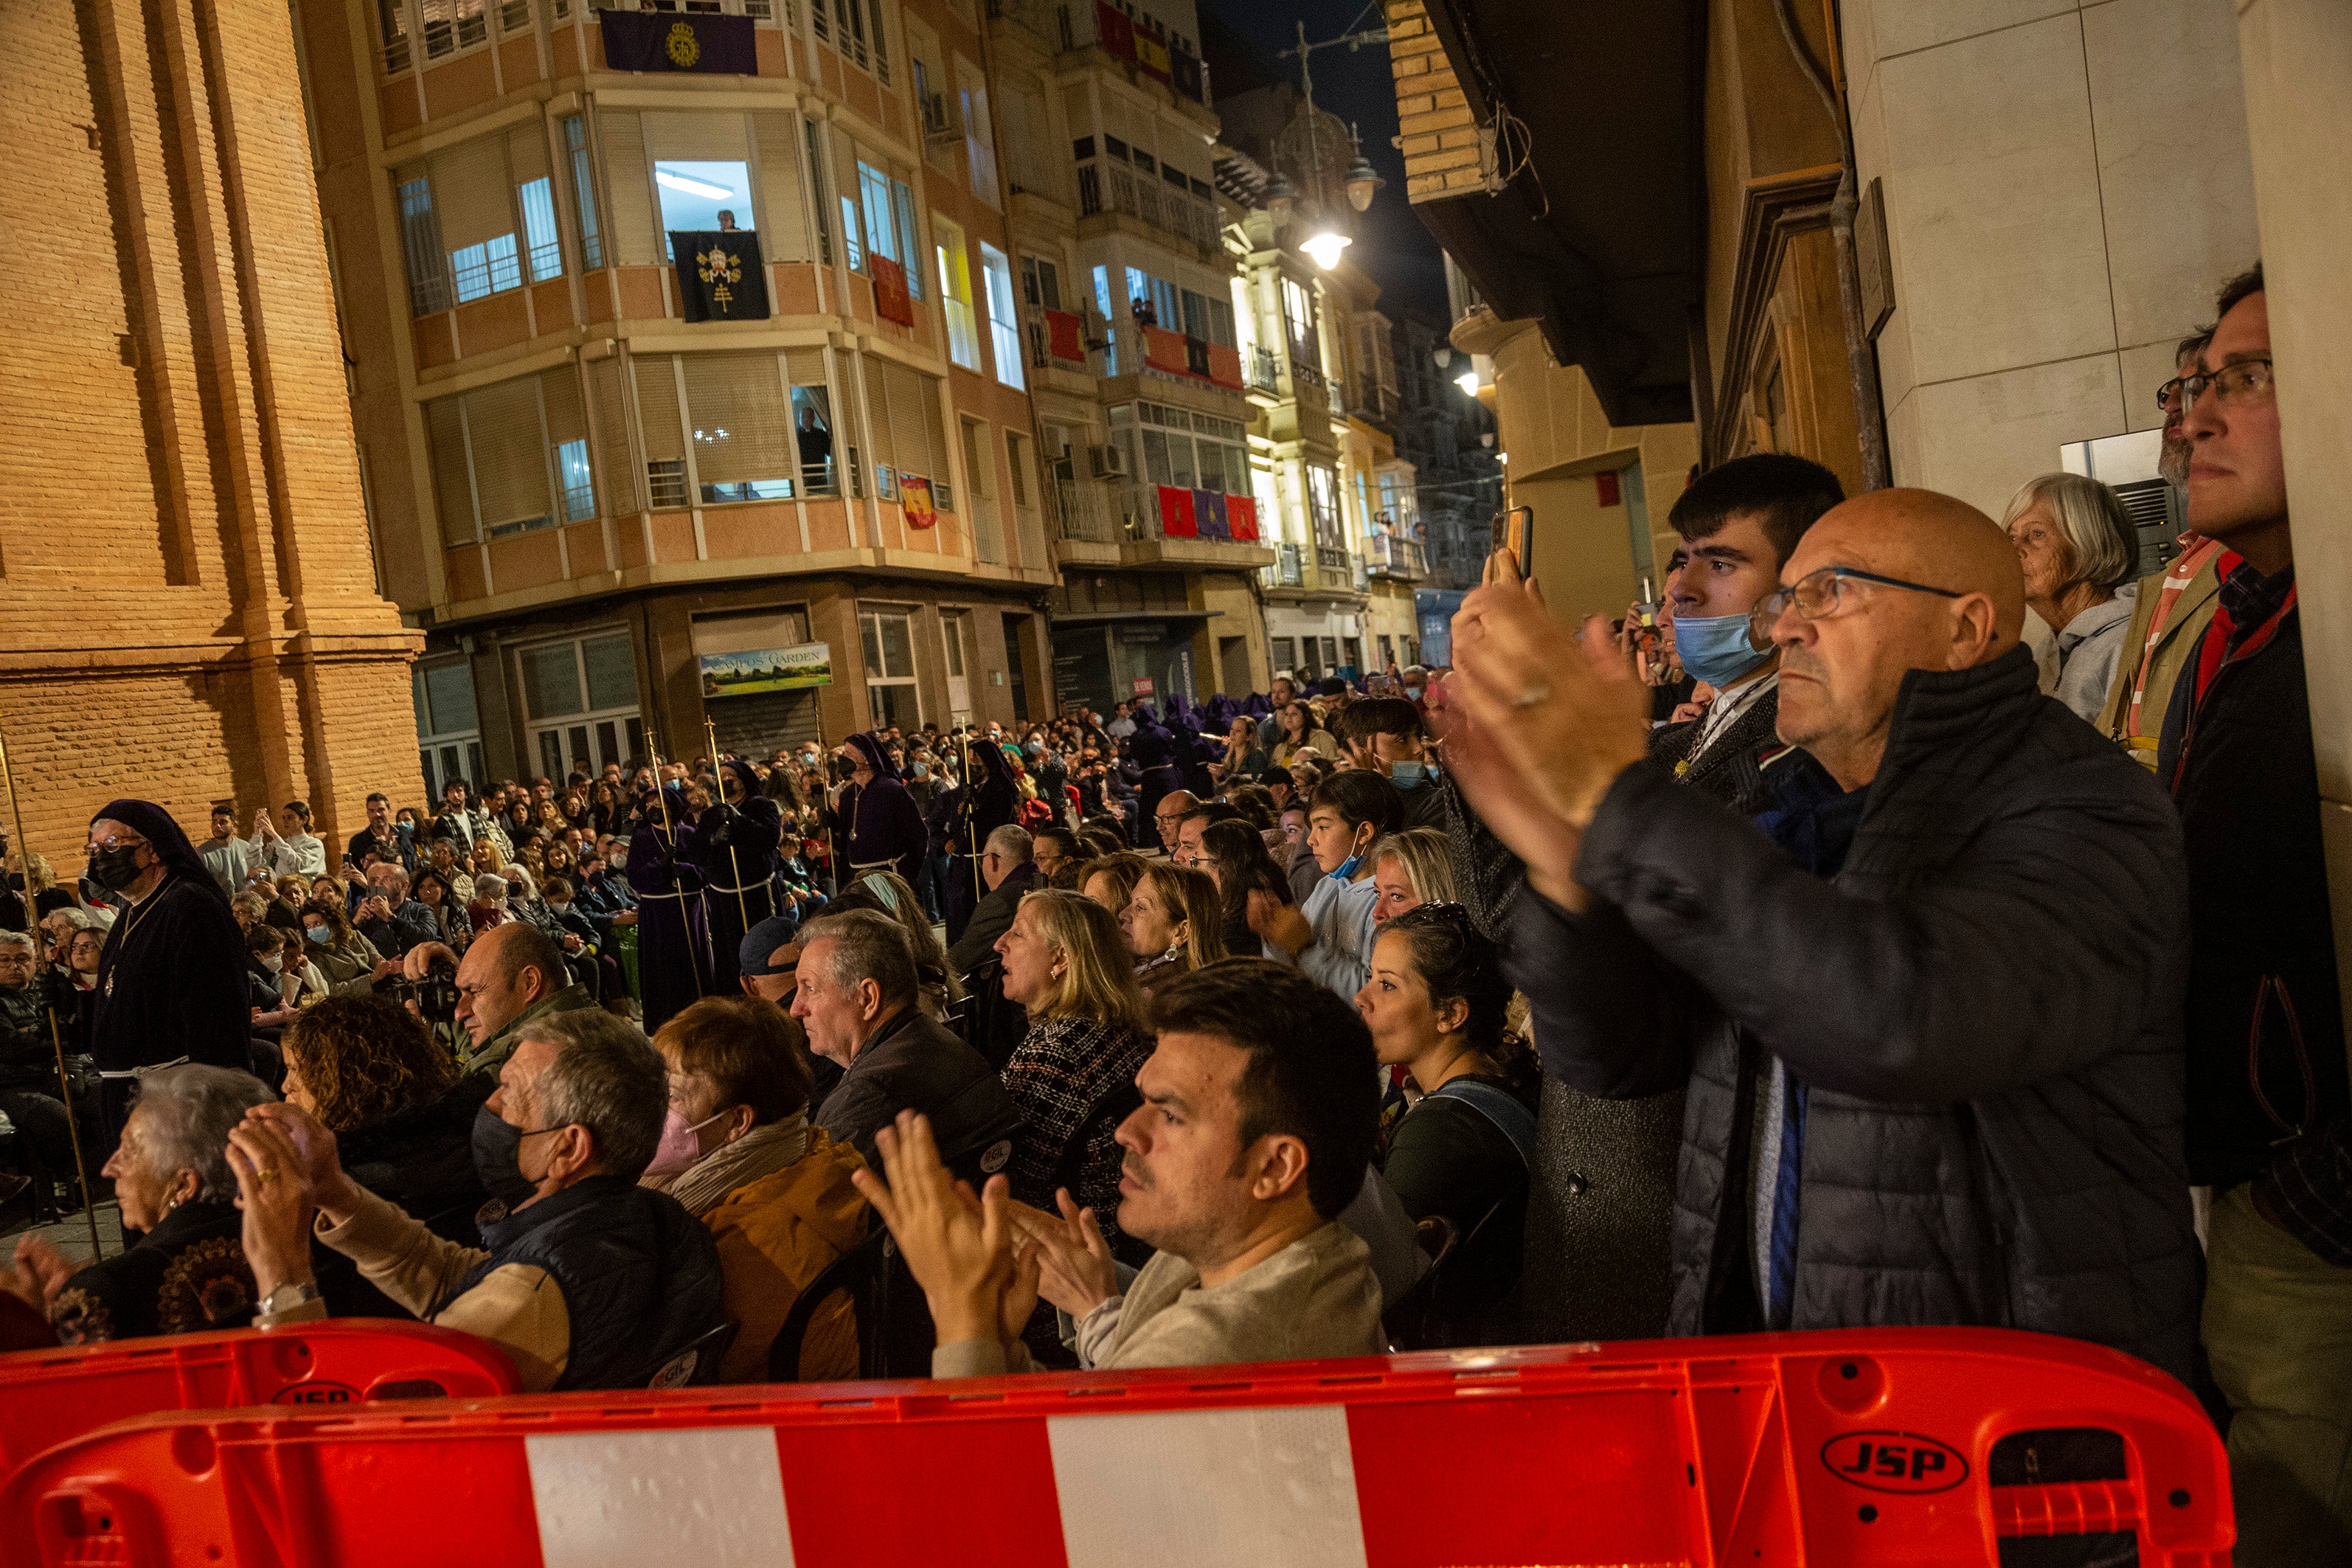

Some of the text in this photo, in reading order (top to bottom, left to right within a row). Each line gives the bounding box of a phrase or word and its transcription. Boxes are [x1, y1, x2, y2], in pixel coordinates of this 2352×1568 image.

[710, 651, 820, 670] CAMPOS GARDEN
[1842, 1442, 1946, 1479] JSP
